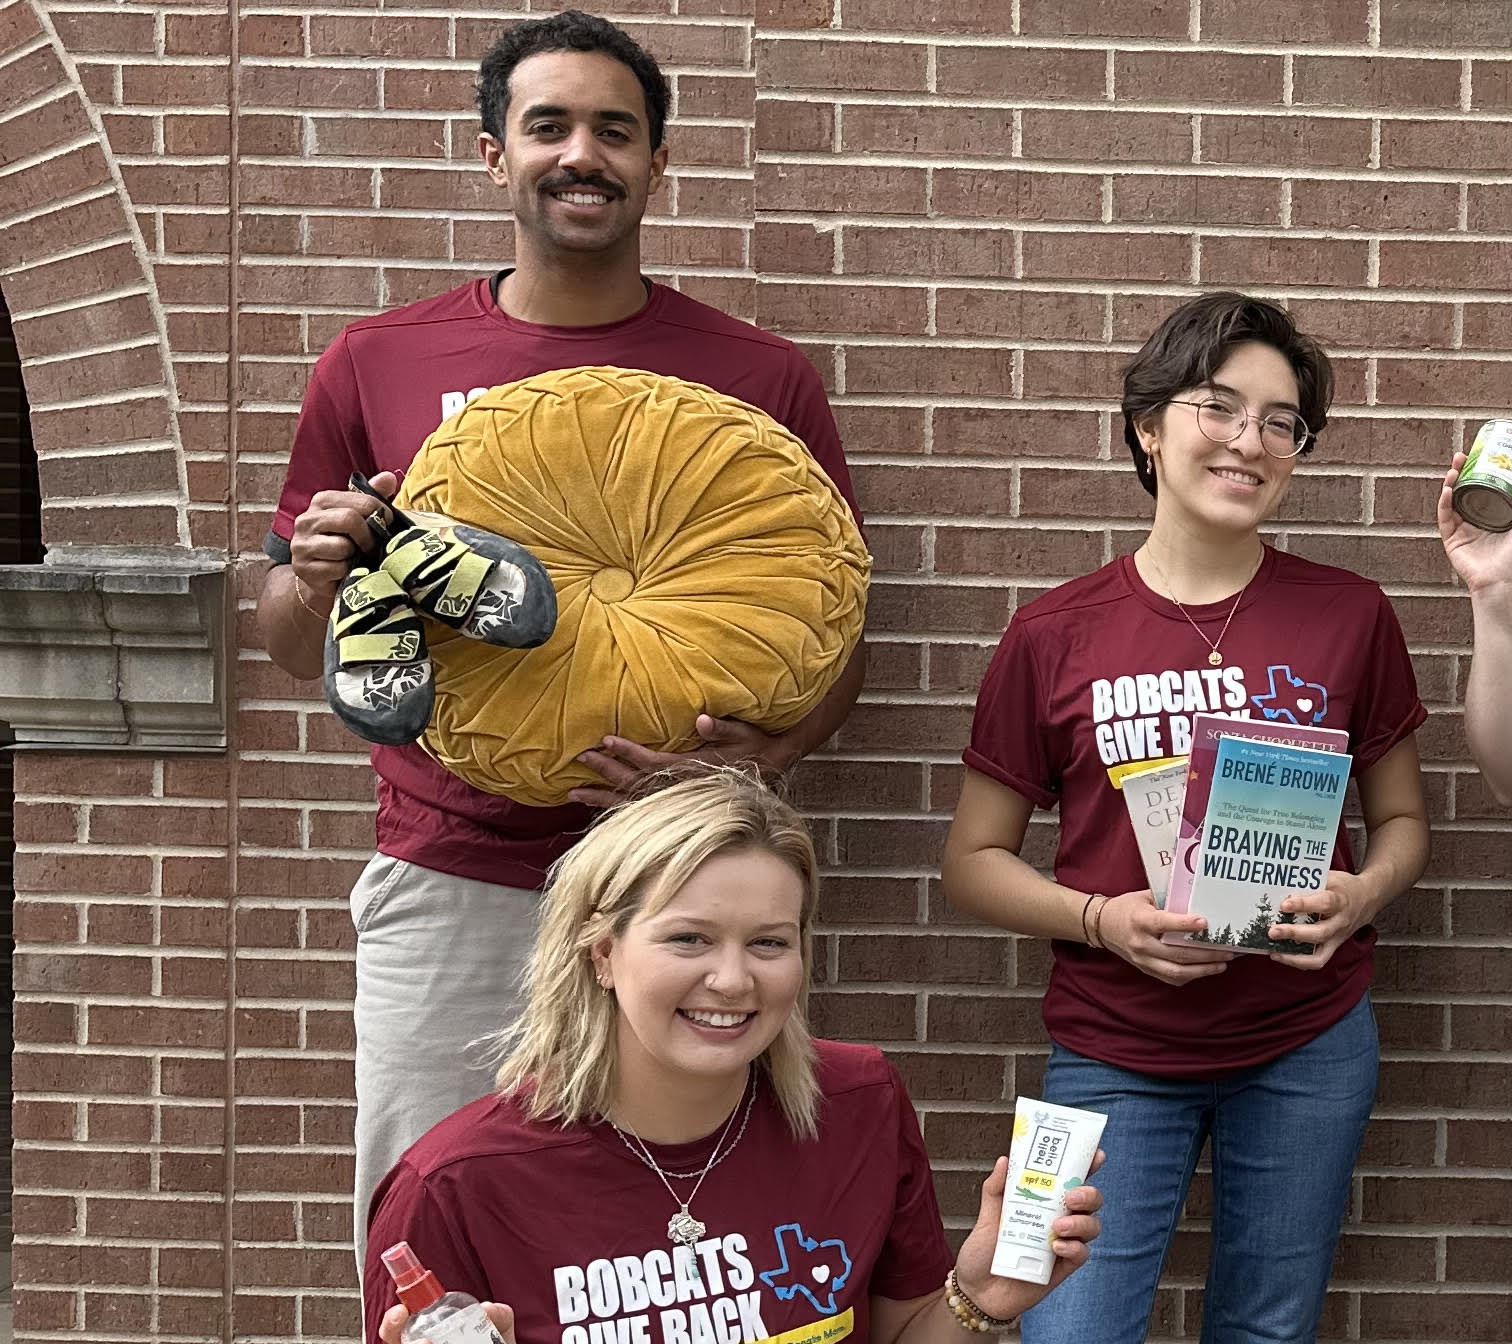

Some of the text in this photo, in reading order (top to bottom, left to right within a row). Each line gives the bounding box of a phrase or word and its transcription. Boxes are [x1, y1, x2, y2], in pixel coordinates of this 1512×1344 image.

[1092, 666, 1247, 723] BOBCATS
[1095, 716, 1164, 765] GIVE
[1222, 758, 1340, 793] BRENÉ BROWN
[1208, 824, 1302, 861] BRAVING
[1306, 839, 1328, 856] THE
[1203, 853, 1322, 890] WILDERNESS
[554, 1233, 754, 1324] BOBCATS
